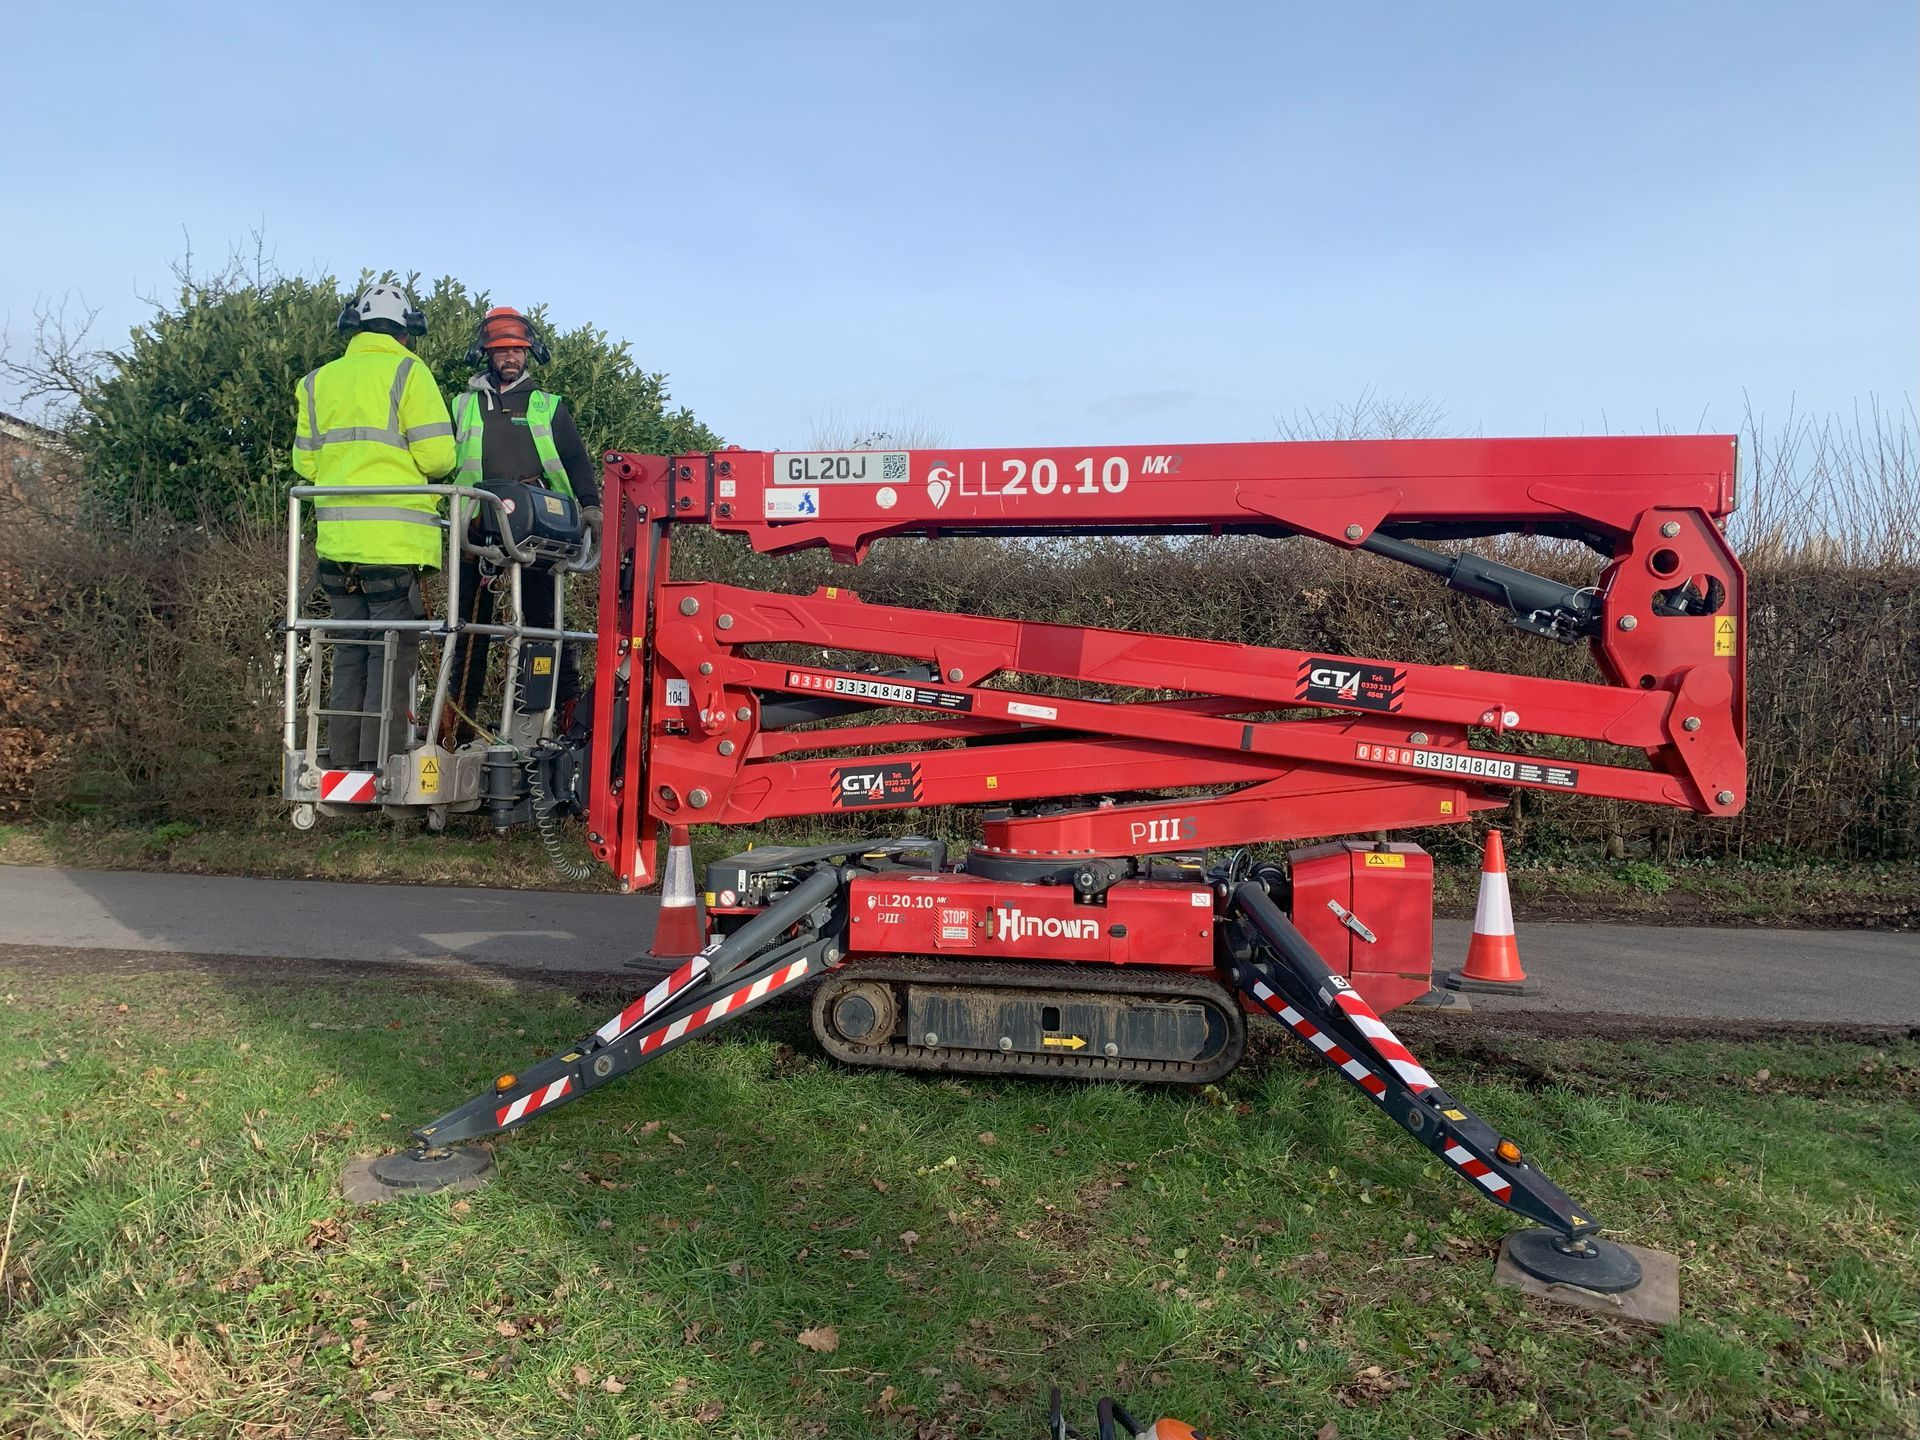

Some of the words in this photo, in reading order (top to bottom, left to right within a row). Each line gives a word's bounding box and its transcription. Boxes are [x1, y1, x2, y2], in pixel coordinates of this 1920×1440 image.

[788, 456, 866, 480] GL20J
[1361, 682, 1378, 690] 0330
[668, 691, 683, 703] 104
[942, 909, 969, 925] STOP!
[1333, 976, 1347, 987] 3
